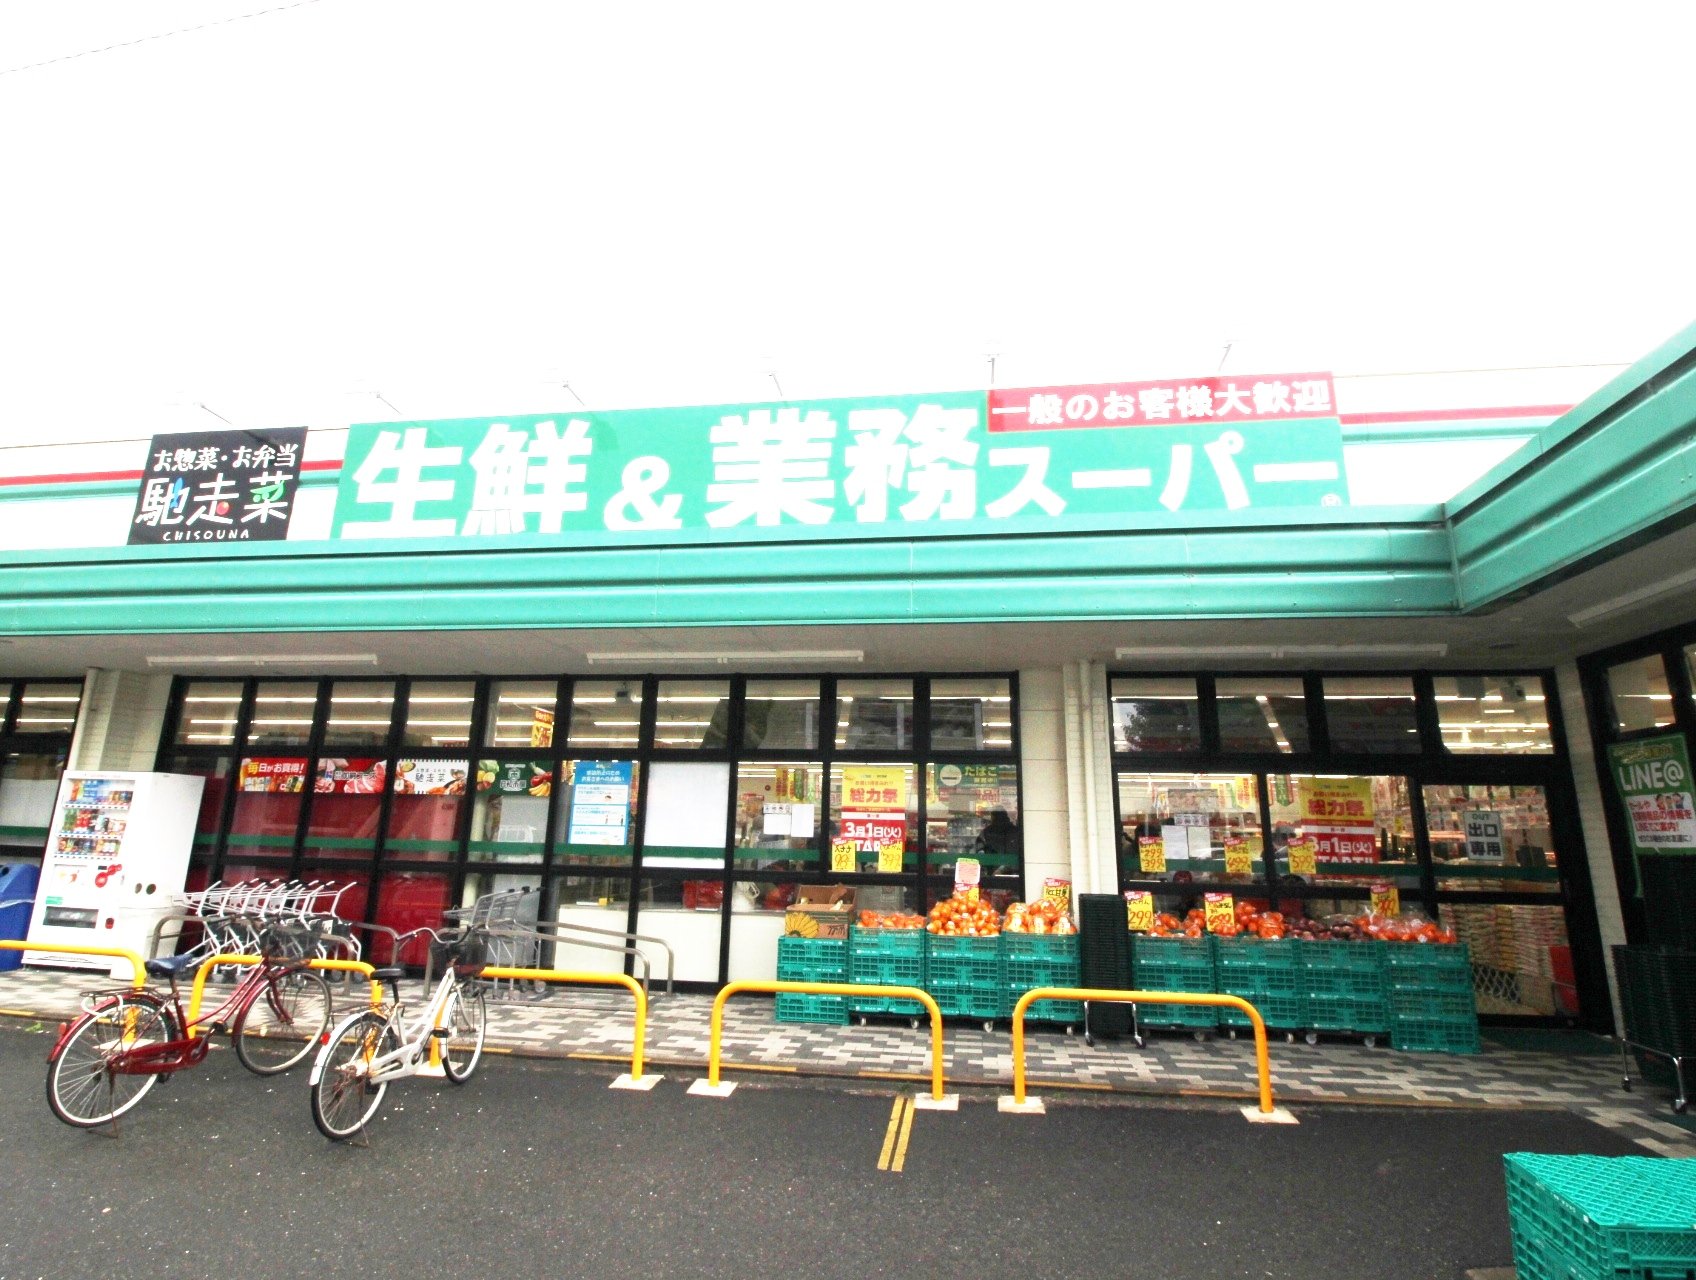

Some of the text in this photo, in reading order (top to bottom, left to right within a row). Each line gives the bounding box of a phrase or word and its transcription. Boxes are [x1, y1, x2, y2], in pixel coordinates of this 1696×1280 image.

[991, 378, 1332, 424] 一般のお客様大歓迎
[154, 443, 298, 472] お惣菜・お弁当
[135, 471, 294, 527] 馳走菜
[162, 528, 250, 542] CHISOUNA
[247, 761, 304, 775] 毎日がお買得!
[1618, 760, 1685, 791] LINE@
[849, 787, 898, 803] 総力祭
[1308, 799, 1364, 816] 総力祭
[845, 821, 902, 838] 3月1日(火)
[1468, 823, 1498, 837] 出口
[1470, 841, 1501, 855] 専用
